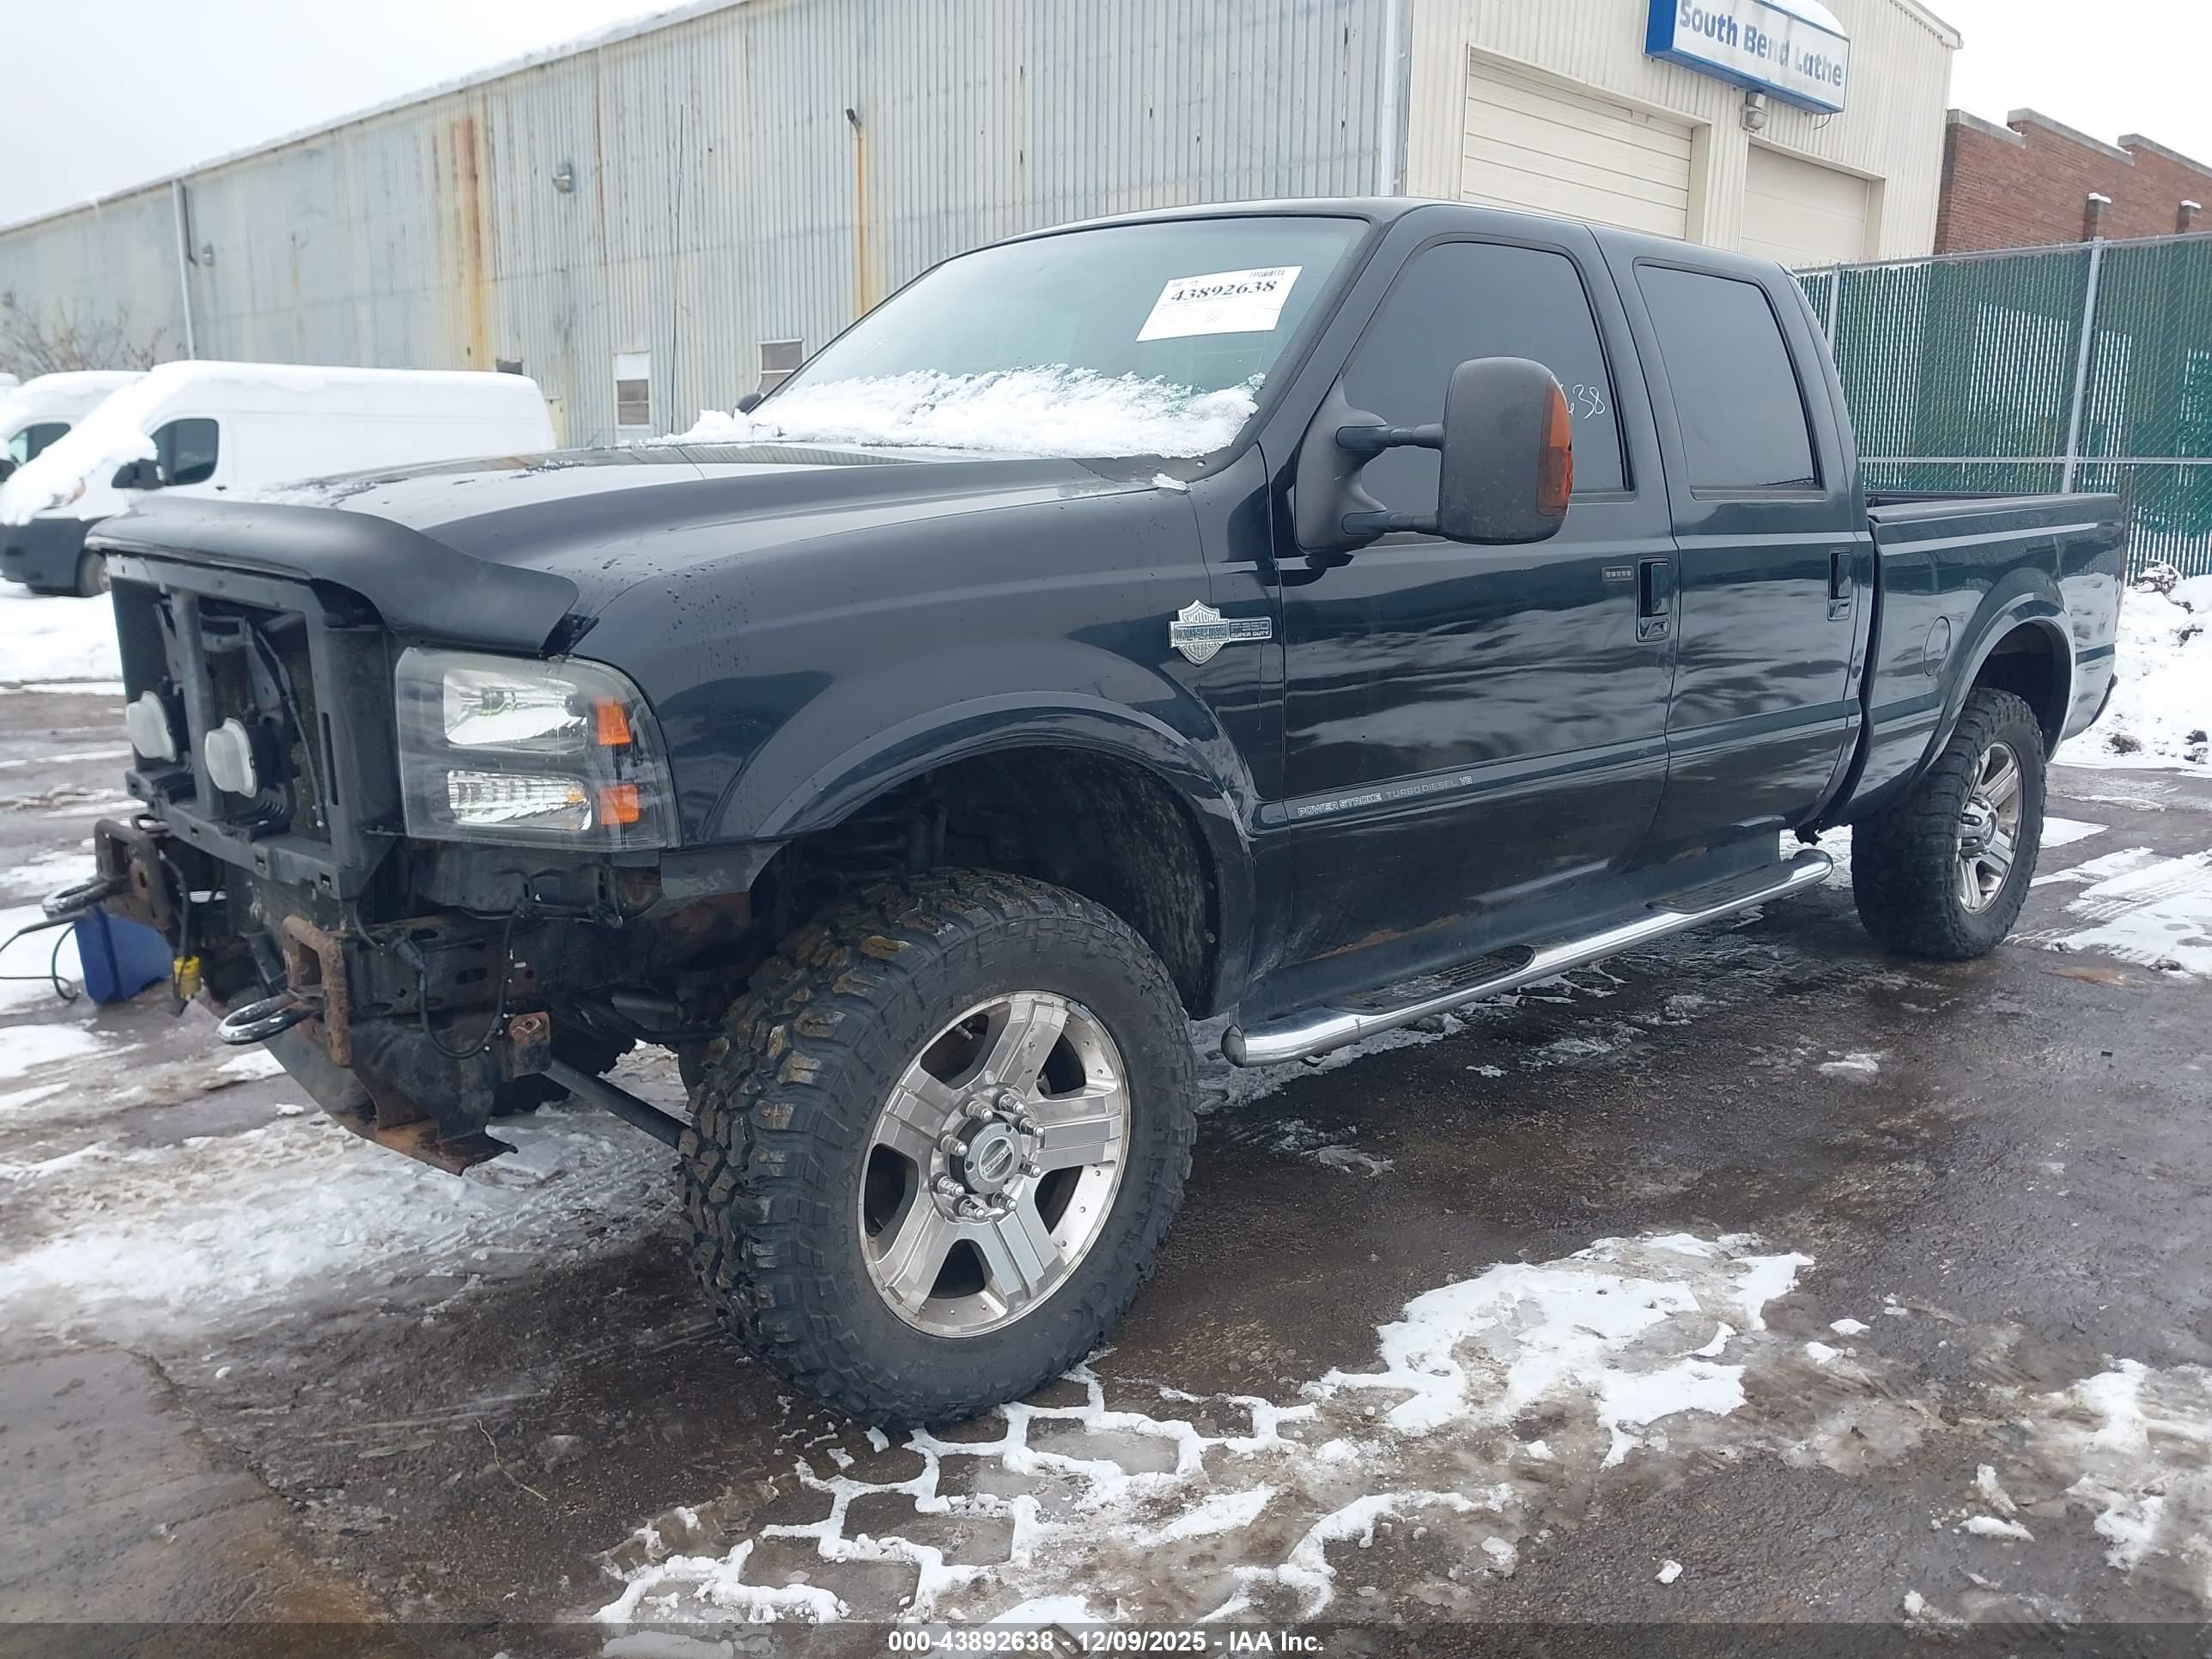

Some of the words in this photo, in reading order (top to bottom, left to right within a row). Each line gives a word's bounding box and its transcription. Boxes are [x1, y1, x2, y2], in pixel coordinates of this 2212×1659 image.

[1680, 0, 1738, 47] South
[1743, 24, 1790, 68] Bend
[1795, 46, 1842, 87] Lathe
[1170, 280, 1278, 301] 43892638
[1297, 801, 1339, 817] POWER
[1340, 793, 1382, 808] STROKE
[1386, 785, 1421, 799] TURBO
[1422, 780, 1457, 793] DIESEL
